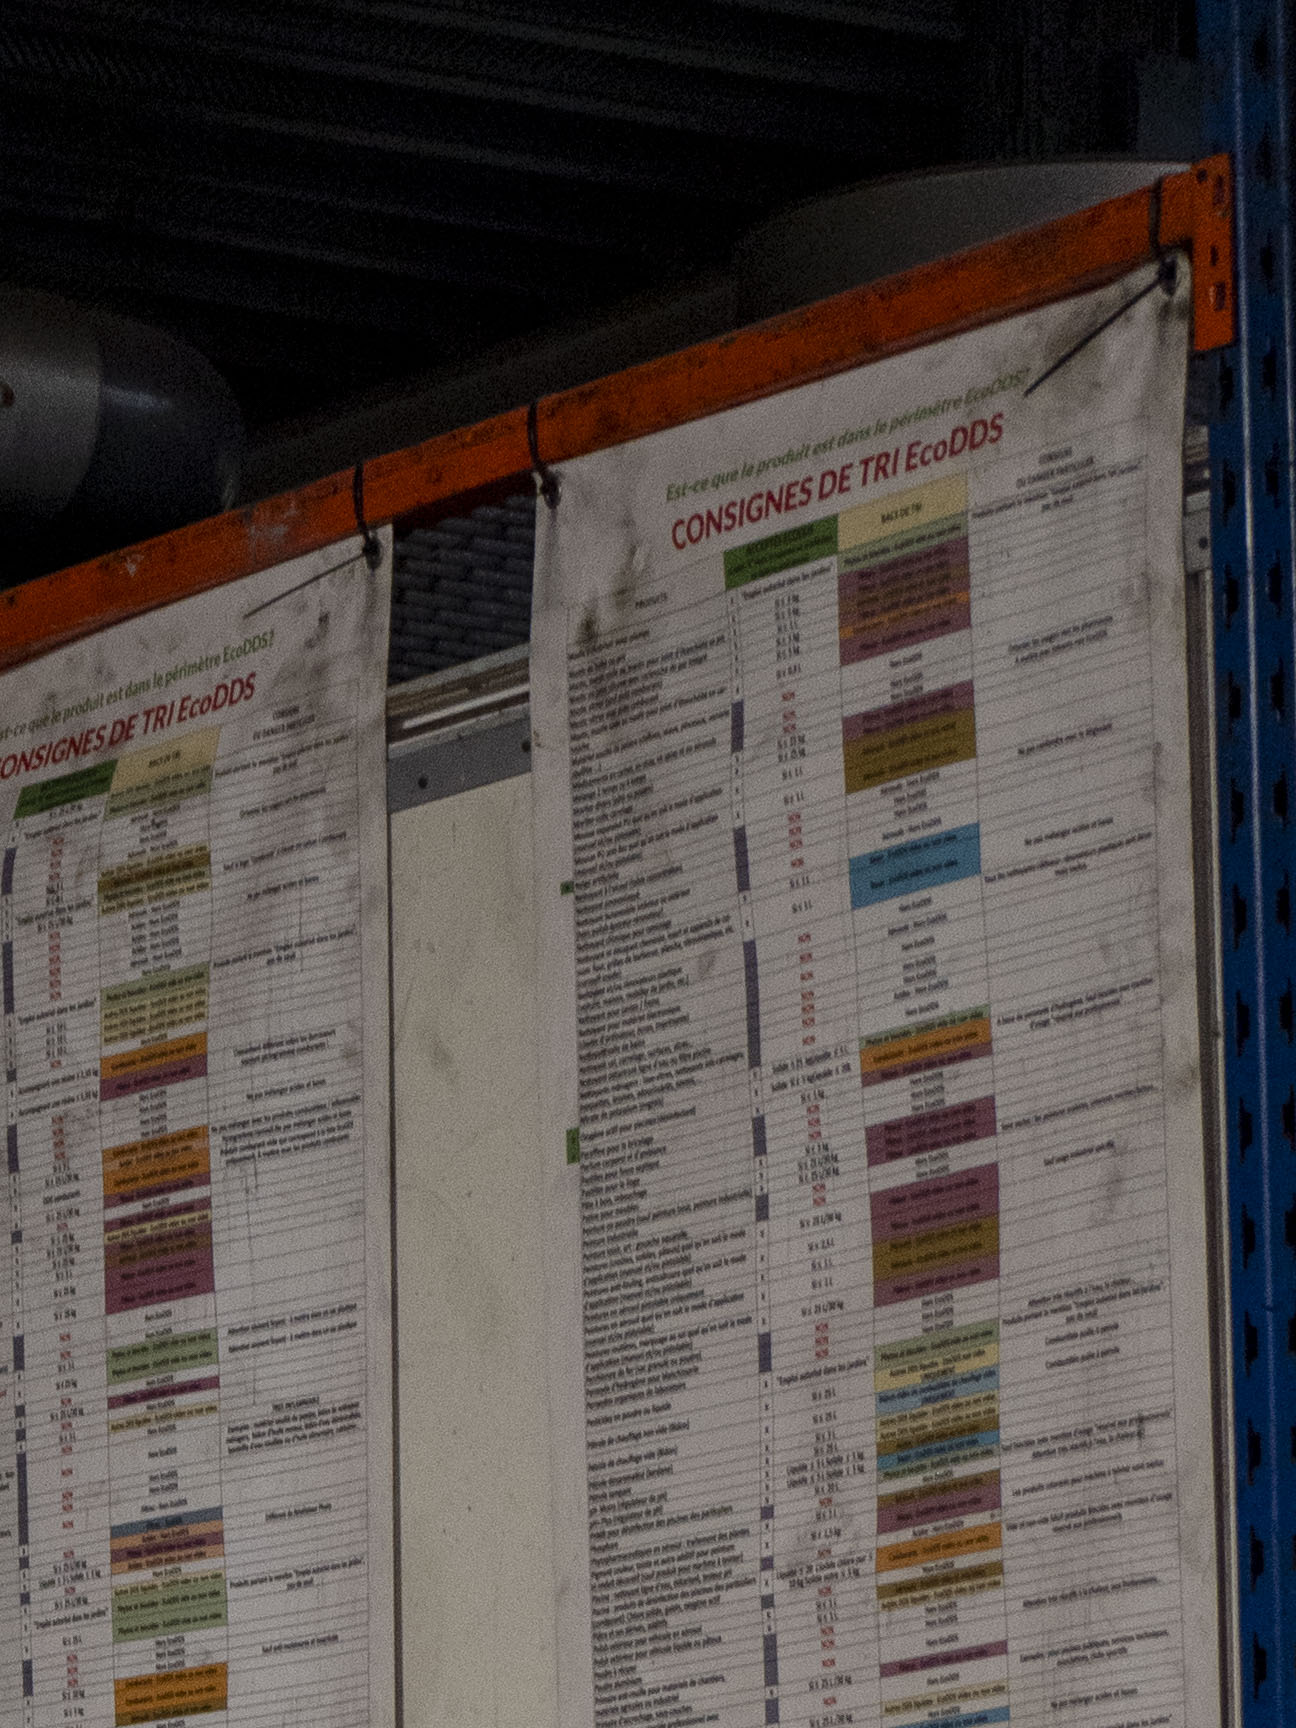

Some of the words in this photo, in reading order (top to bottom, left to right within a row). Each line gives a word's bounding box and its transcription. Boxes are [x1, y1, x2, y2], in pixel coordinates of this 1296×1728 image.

[665, 478, 708, 501] Est-ce
[710, 467, 738, 489] que
[741, 459, 755, 477] le
[756, 442, 810, 474] produit
[812, 437, 833, 454] est
[837, 425, 871, 446] dans
[875, 418, 888, 434] le
[889, 398, 962, 431] périmètre
[670, 476, 813, 550] CONSIGNES
[817, 464, 852, 500] DE
[860, 447, 899, 484] TRI
[904, 412, 1003, 472] EcoDDS
[62, 693, 104, 721] produit
[106, 689, 123, 704] est
[124, 678, 149, 697] dans
[153, 672, 162, 687] le
[164, 655, 221, 685] périmètre
[108, 714, 137, 747] DE
[143, 701, 174, 732] TRI
[176, 673, 255, 722] EcoDDS
